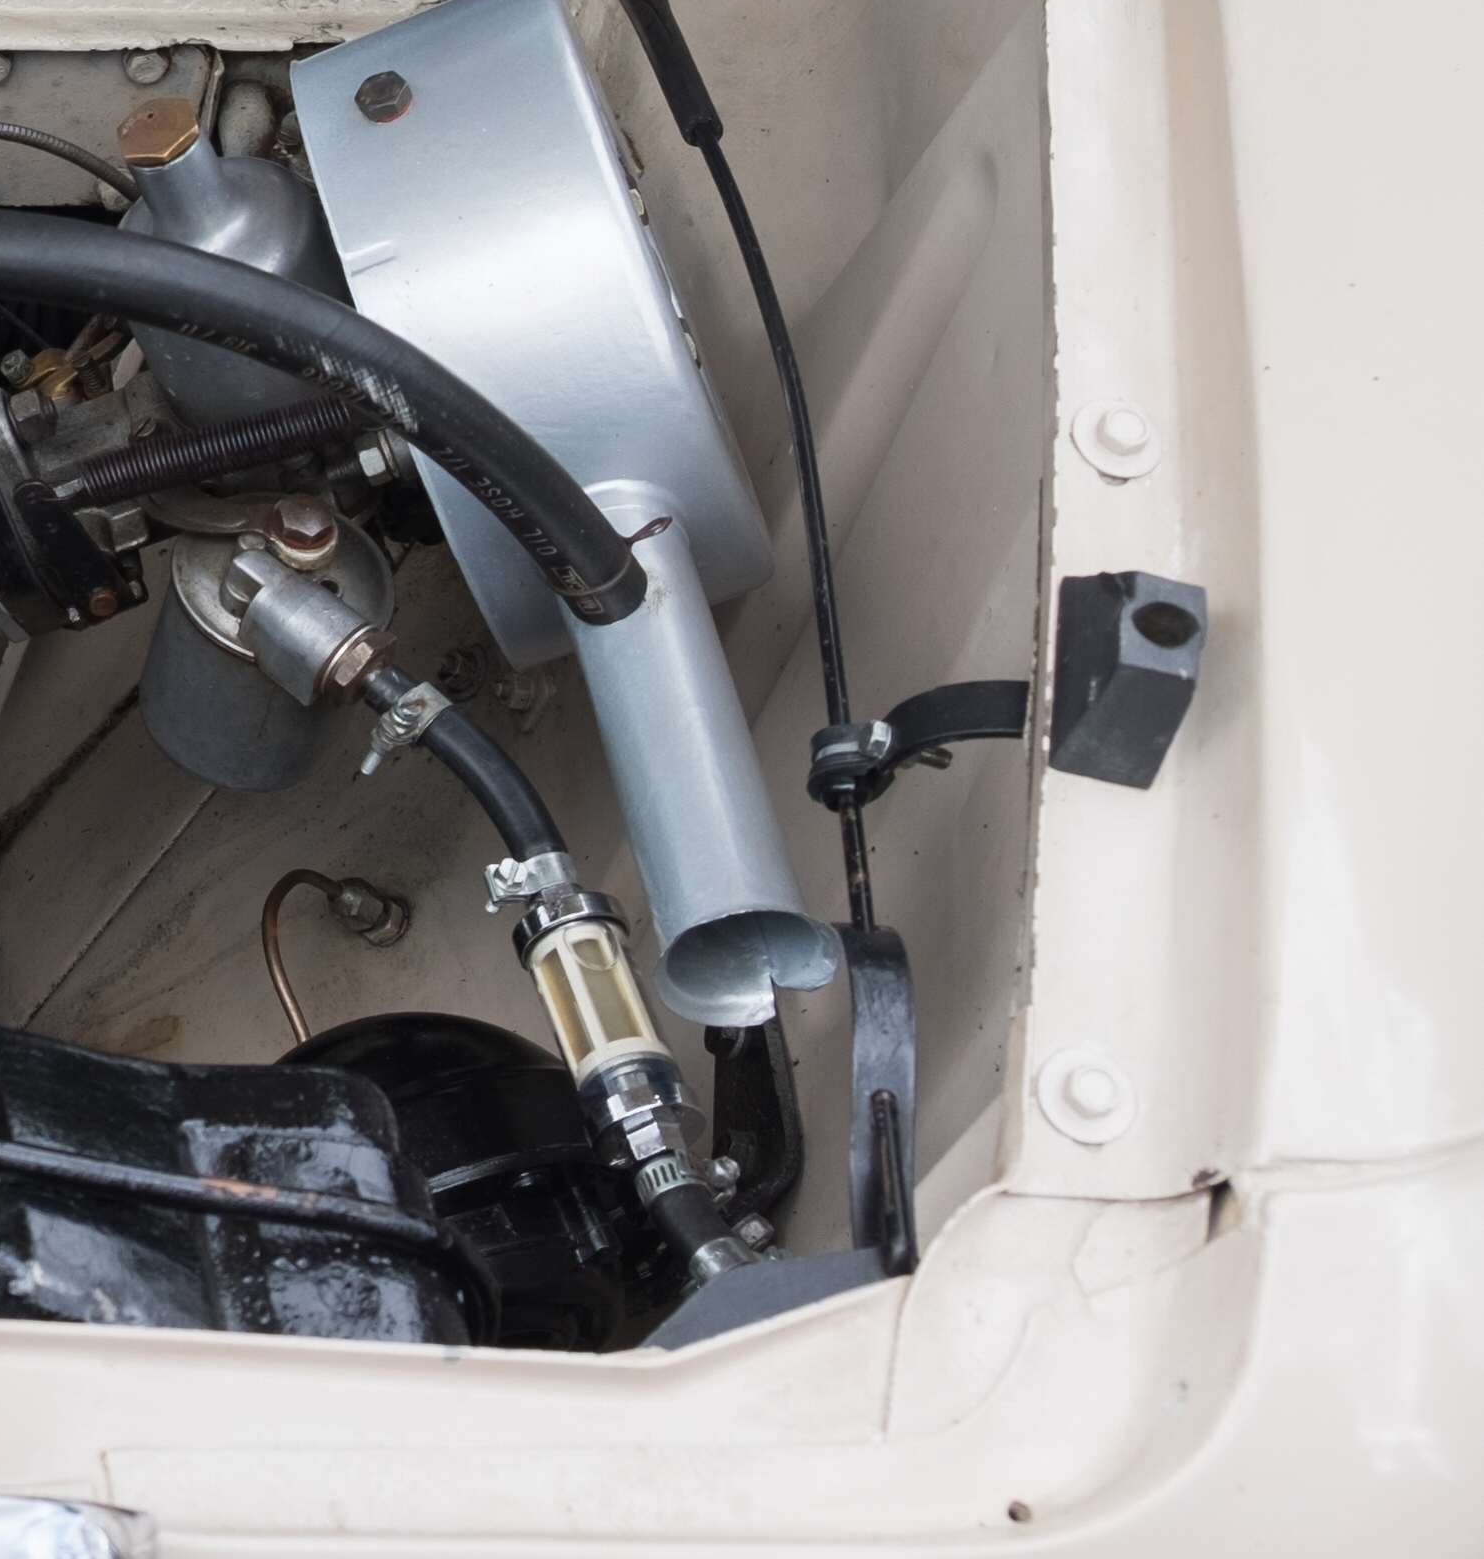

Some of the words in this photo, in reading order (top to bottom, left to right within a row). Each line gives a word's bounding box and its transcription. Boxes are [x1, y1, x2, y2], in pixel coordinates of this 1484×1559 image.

[432, 446, 470, 471] 1/2
[469, 477, 525, 519] HOSE
[523, 527, 558, 556] OIL
